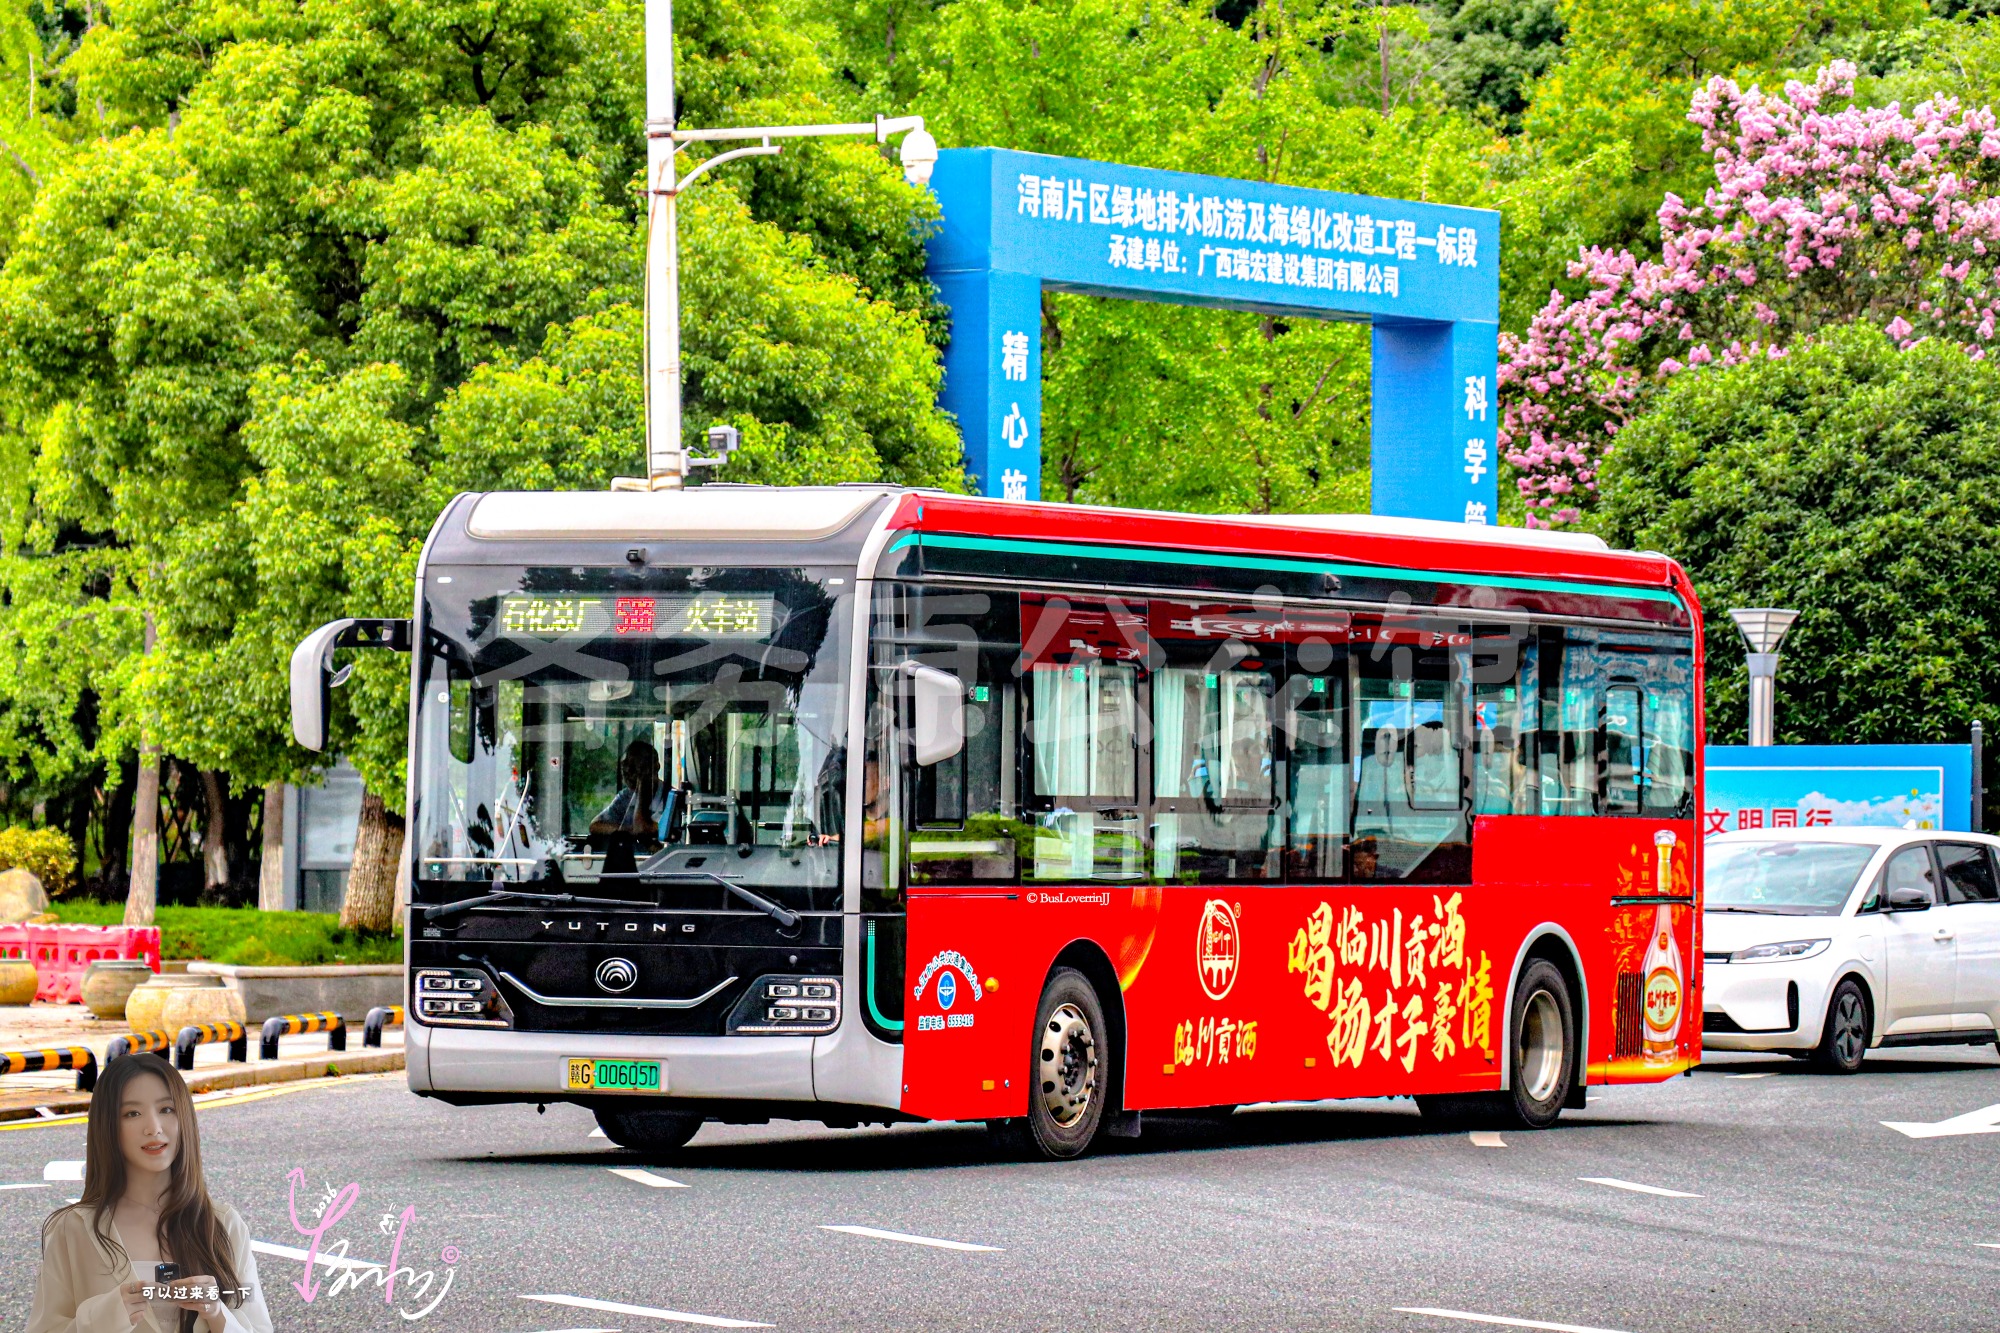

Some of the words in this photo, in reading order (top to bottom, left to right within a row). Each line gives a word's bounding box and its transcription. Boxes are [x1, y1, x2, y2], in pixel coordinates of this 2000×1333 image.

[1017, 173, 1478, 268] 浔南片区绿地排水防涝及海绵化改造工程一标段
[502, 600, 602, 632] 石化总厂
[683, 598, 760, 633] 火车站
[541, 921, 695, 933] YUTONG
